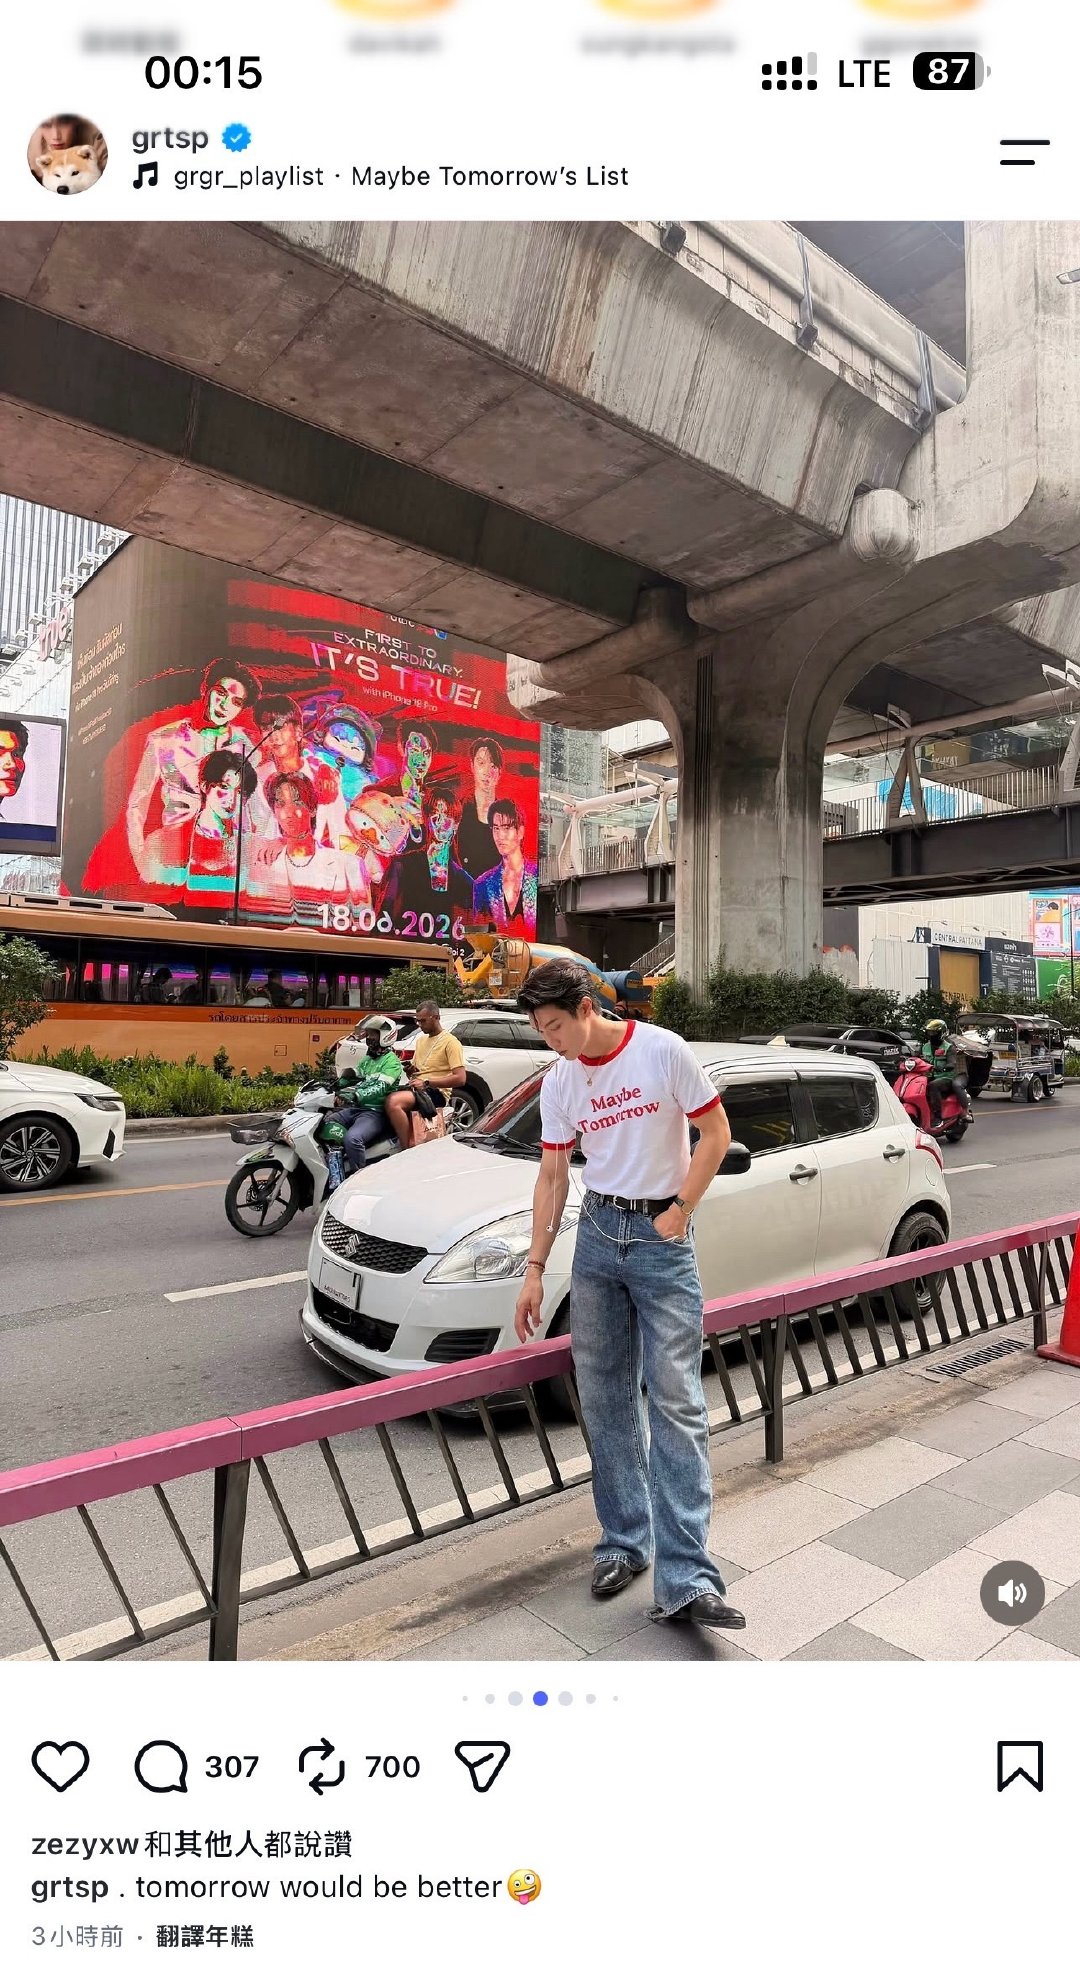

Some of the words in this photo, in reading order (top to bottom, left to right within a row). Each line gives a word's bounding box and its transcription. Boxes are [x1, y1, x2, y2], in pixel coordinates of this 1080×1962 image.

[333, 631, 464, 678] EXTRAORDINARY.
[418, 644, 437, 660] TO
[363, 686, 381, 697] with
[382, 689, 412, 706] iPhone
[391, 664, 482, 710] TRUE!
[590, 1087, 642, 1112] Maybe
[578, 1101, 660, 1133] Tomorrow
